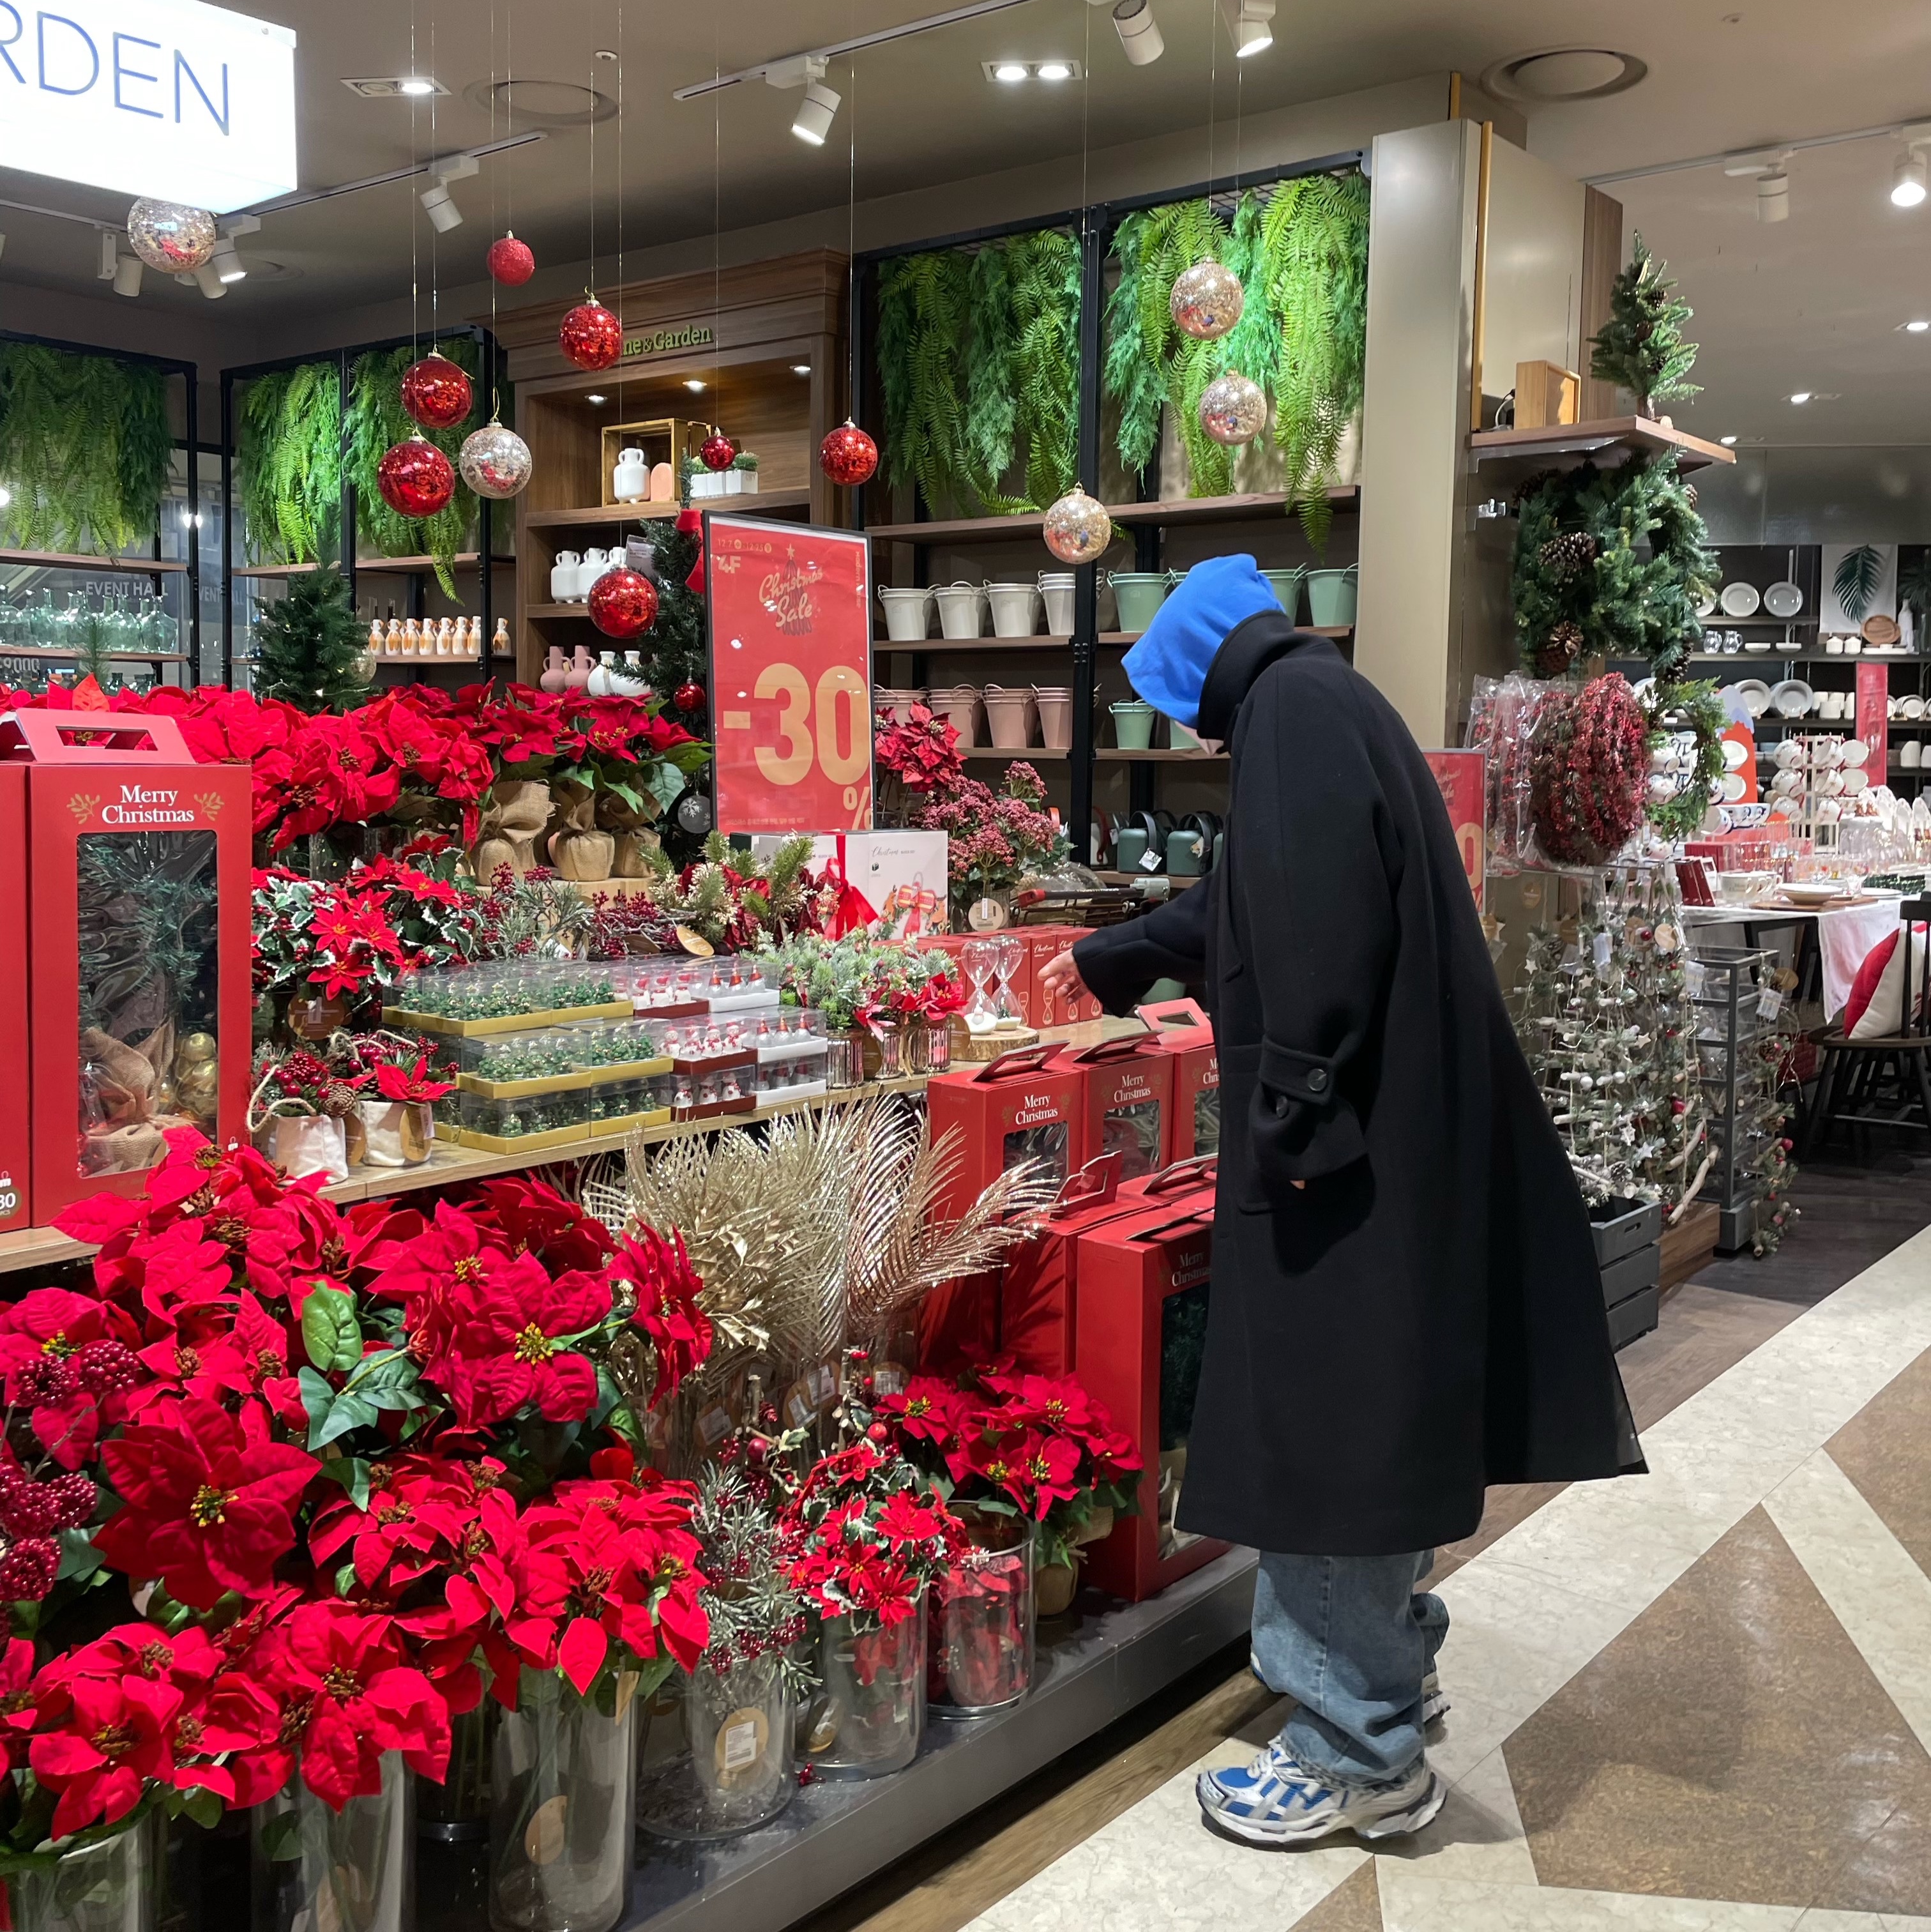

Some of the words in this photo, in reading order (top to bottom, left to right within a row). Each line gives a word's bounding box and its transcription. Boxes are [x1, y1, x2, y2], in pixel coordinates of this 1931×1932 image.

[86, 581, 130, 596] EVENT
[133, 582, 169, 596] HAL
[759, 567, 823, 603] Christmas
[776, 592, 812, 628] Sale
[120, 785, 178, 806] Merry
[102, 805, 194, 824] Christmas
[1122, 1074, 1145, 1088] Merry
[1024, 1094, 1050, 1110] Merry
[1114, 1086, 1151, 1104] Christmas
[1015, 1106, 1058, 1125] Christmas
